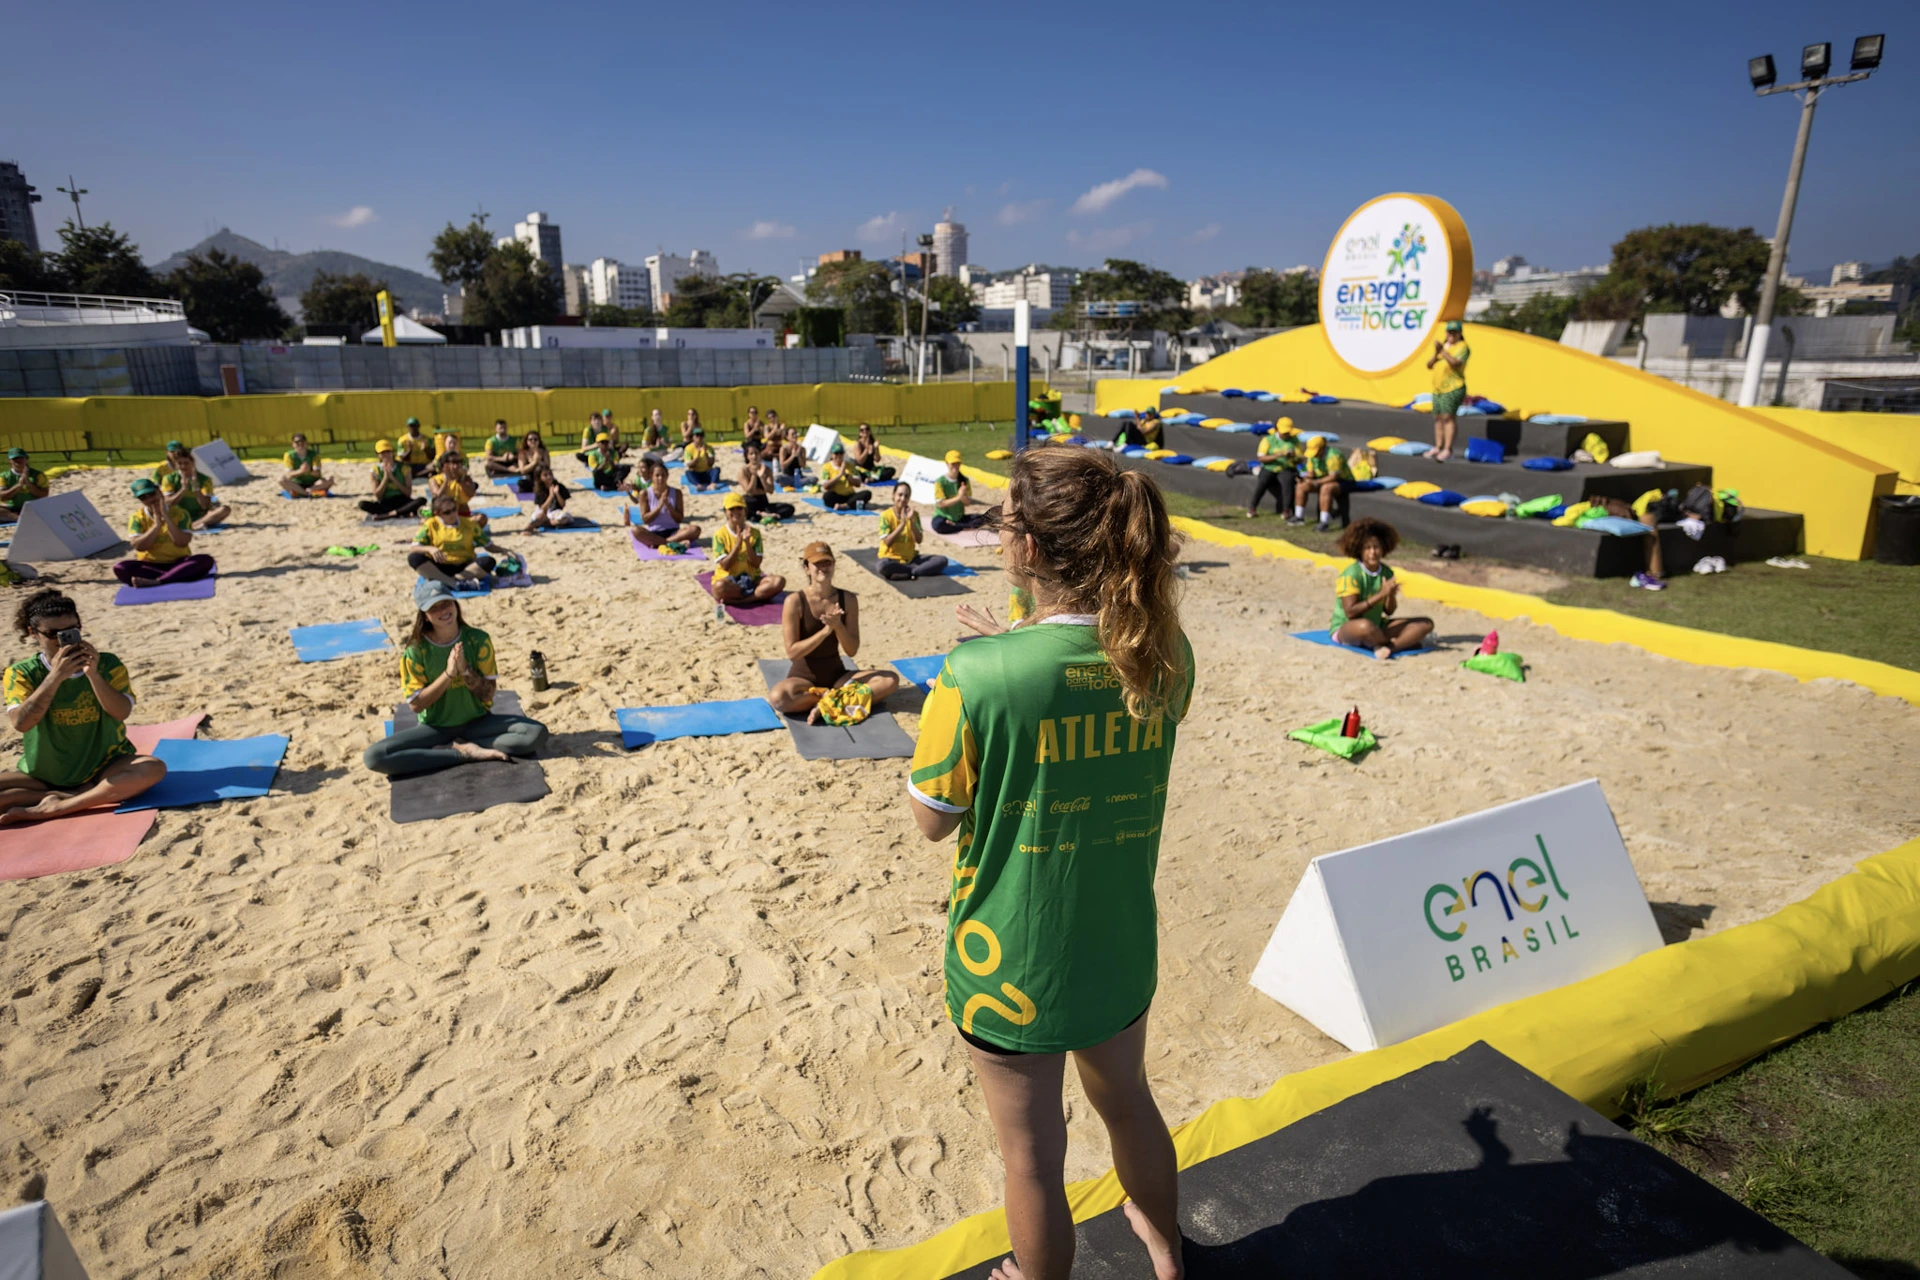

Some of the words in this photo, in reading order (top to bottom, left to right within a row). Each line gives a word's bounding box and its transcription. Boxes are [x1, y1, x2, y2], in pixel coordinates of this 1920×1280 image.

[1336, 273, 1421, 308] energia
[1362, 304, 1428, 330] torcer
[1088, 676, 1120, 691] torc
[1034, 707, 1164, 764] ATLETA
[1002, 799, 1038, 813] enel
[1424, 834, 1569, 942] enel
[1445, 914, 1580, 982] BRASIL
